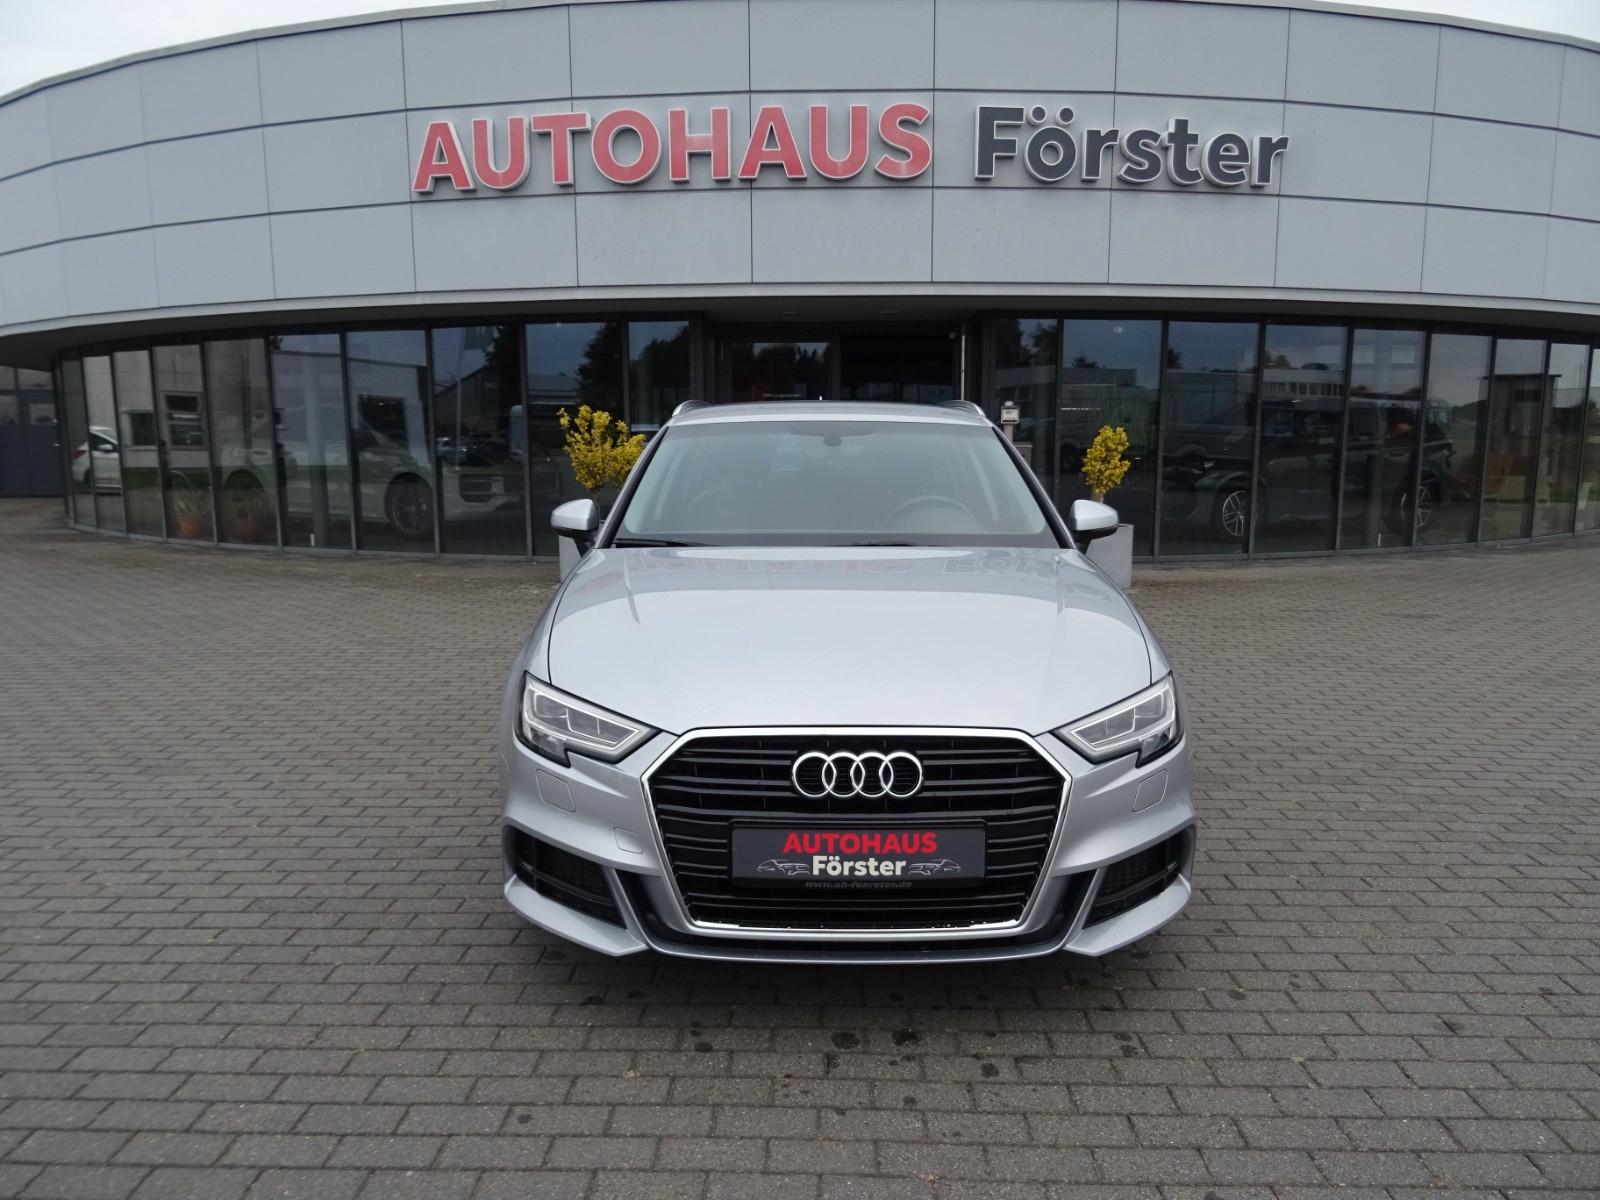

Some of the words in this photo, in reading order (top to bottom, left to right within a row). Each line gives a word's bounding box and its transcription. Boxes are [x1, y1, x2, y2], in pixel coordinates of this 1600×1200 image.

[411, 102, 933, 193] AUTOHAUS
[974, 104, 1290, 187] Förster
[782, 832, 938, 854] AUTOHAUS
[811, 855, 907, 876] Förster
